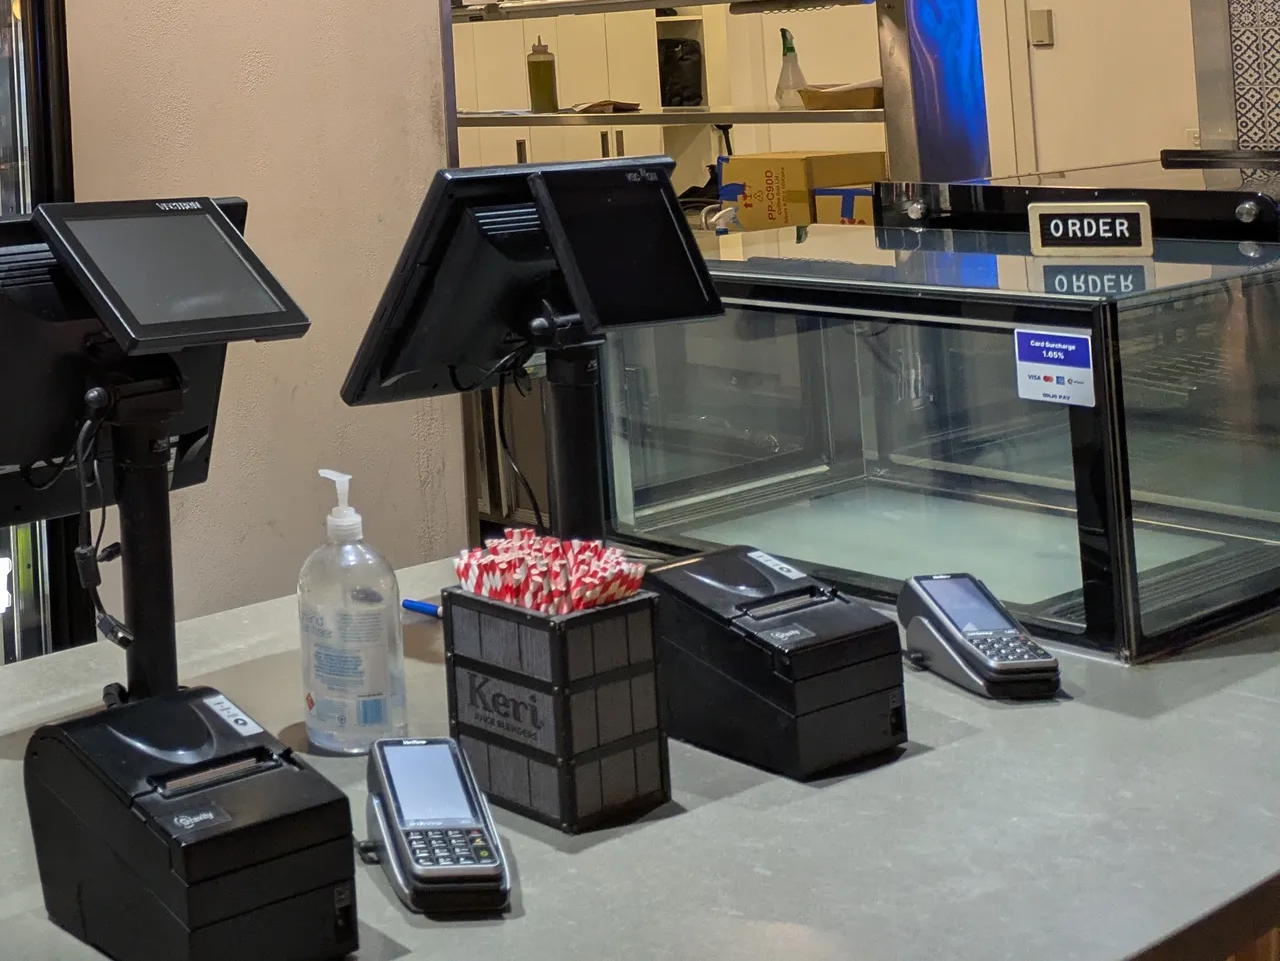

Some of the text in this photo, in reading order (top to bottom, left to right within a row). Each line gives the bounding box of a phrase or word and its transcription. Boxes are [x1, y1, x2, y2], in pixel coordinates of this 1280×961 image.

[1050, 218, 1130, 238] ORDER
[1046, 341, 1076, 351] Surcharge
[1042, 350, 1064, 359] 1.65%
[467, 671, 544, 729] Keri
